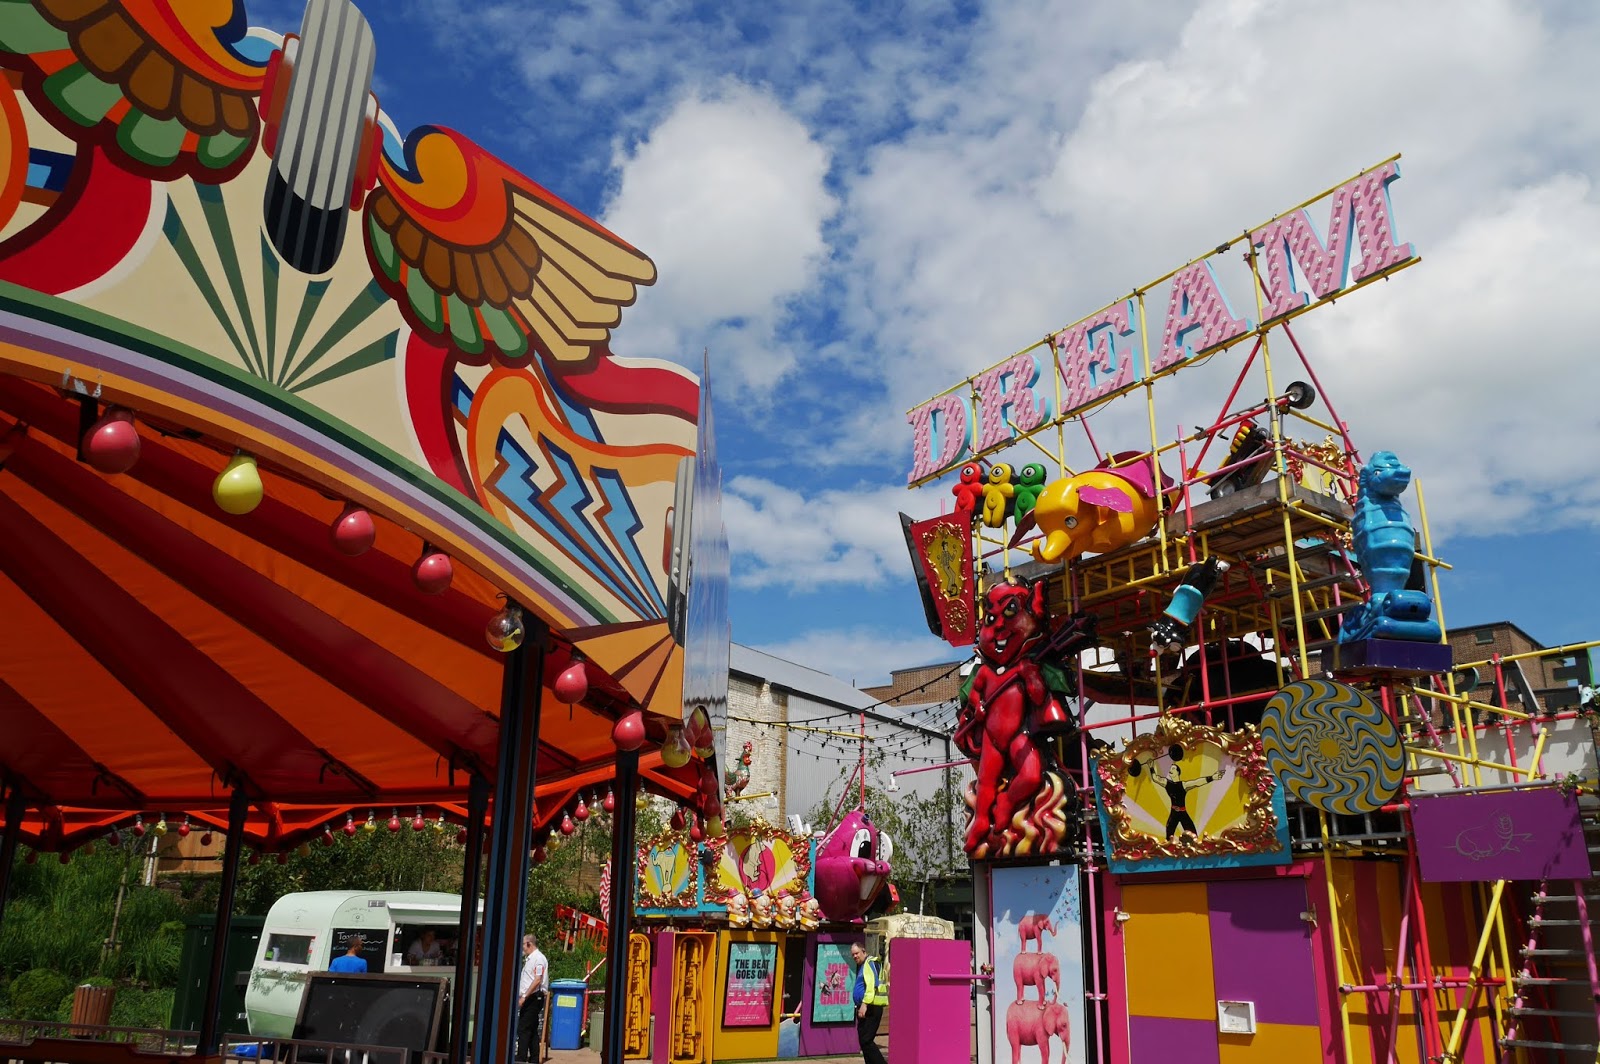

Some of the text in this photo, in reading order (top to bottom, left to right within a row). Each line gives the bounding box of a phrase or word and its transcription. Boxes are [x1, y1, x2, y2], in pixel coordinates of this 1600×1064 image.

[907, 161, 1416, 485] DREAM
[735, 959, 771, 970] THE BEAT
[824, 963, 850, 977] JOIN
[736, 970, 768, 980] GOES ON
[826, 977, 847, 991] TE
[820, 991, 851, 1006] GANG!
